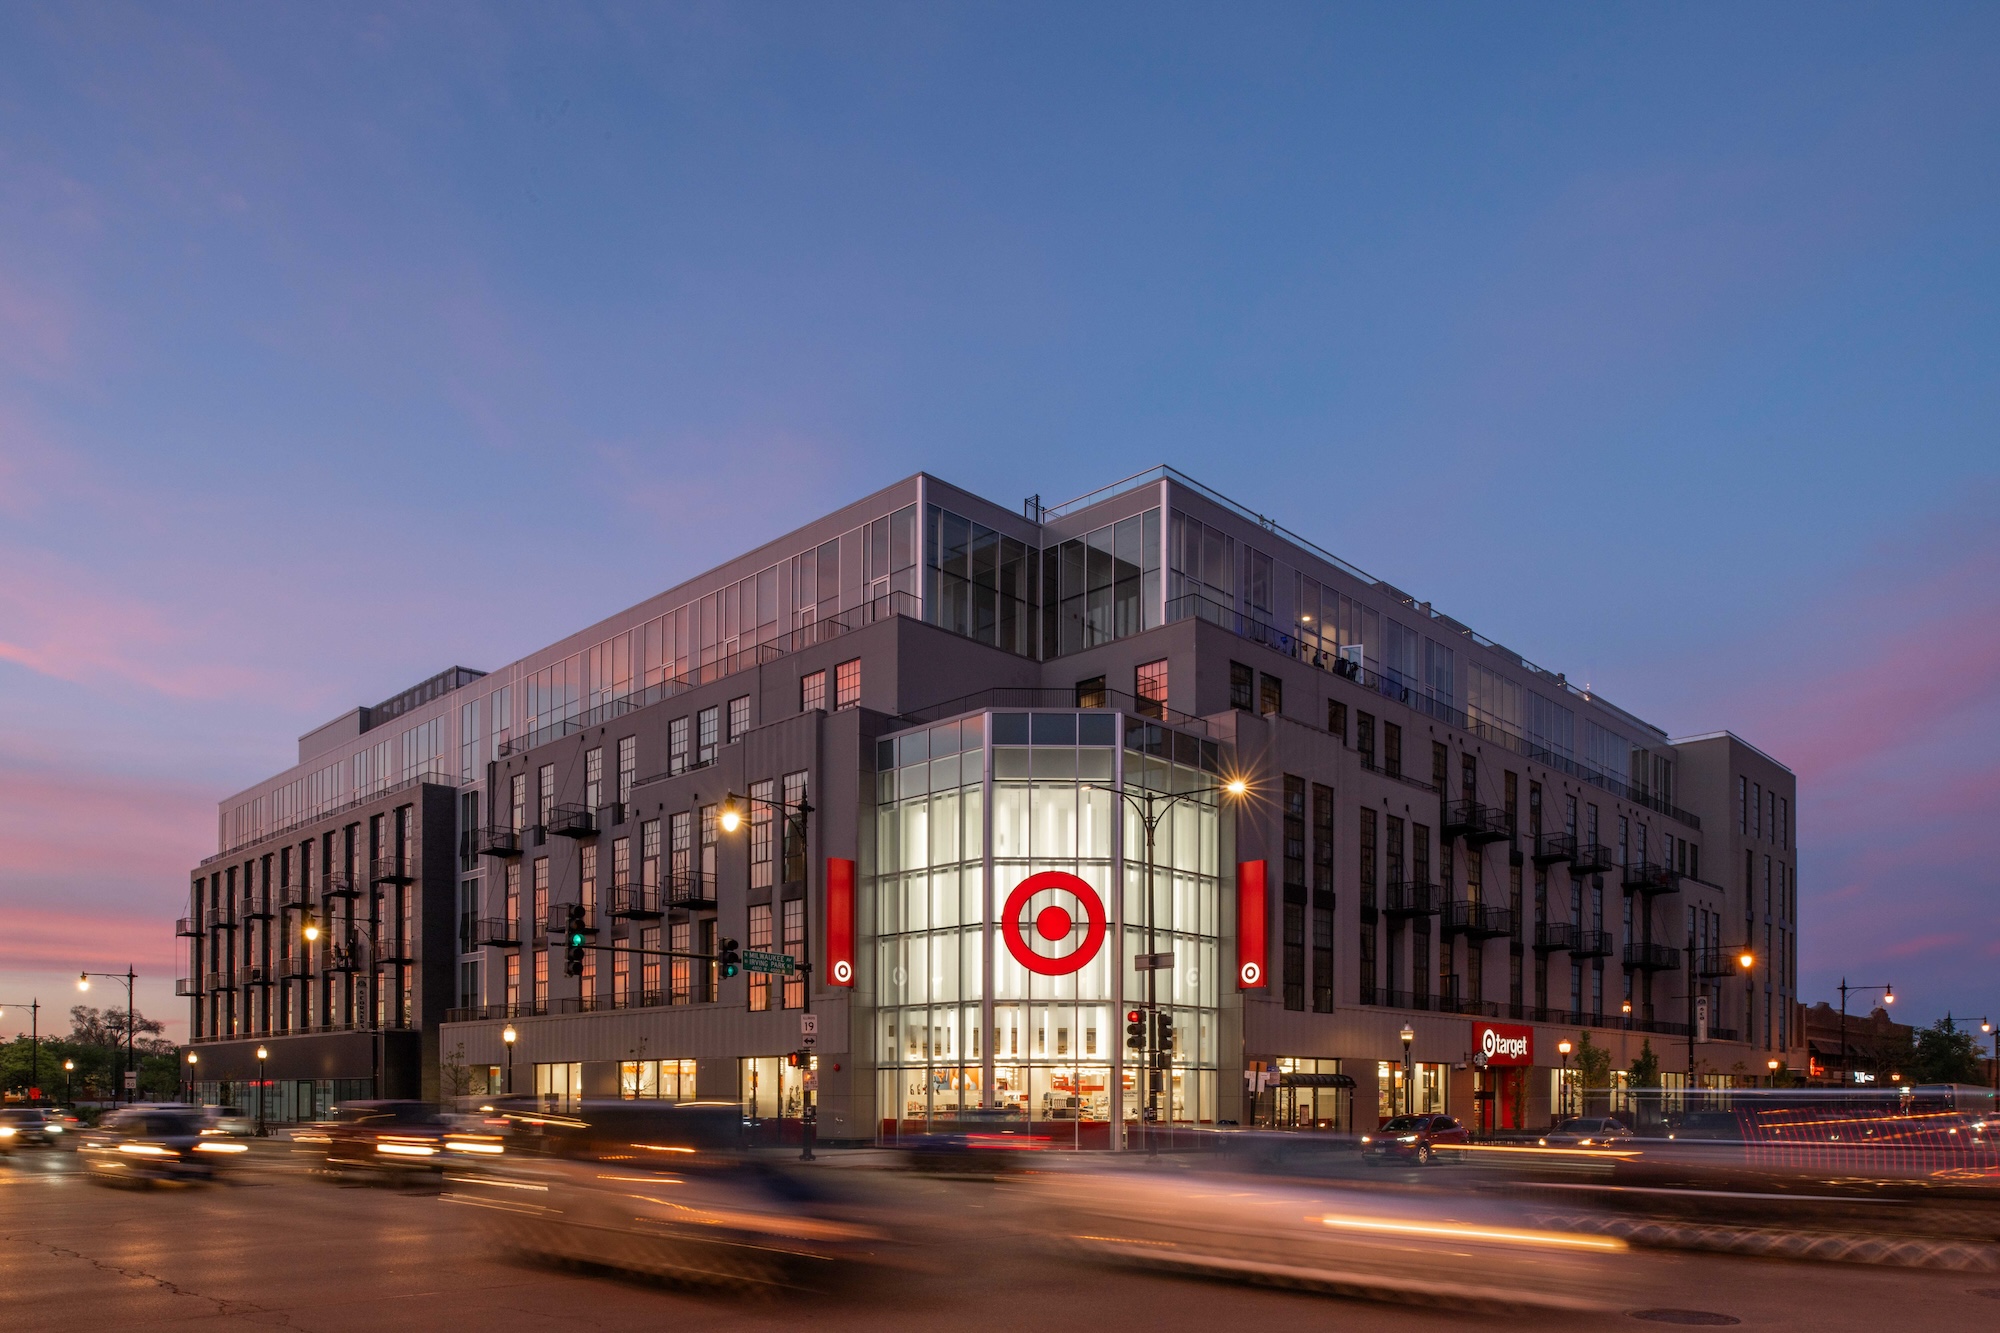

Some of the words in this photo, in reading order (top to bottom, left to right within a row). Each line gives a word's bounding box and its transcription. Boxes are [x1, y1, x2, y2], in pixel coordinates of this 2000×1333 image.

[749, 952, 784, 963] MILWAUKEE
[749, 958, 769, 967] IRVING
[771, 961, 785, 969] PARK
[804, 1021, 814, 1031] 19
[1496, 1034, 1527, 1059] target
